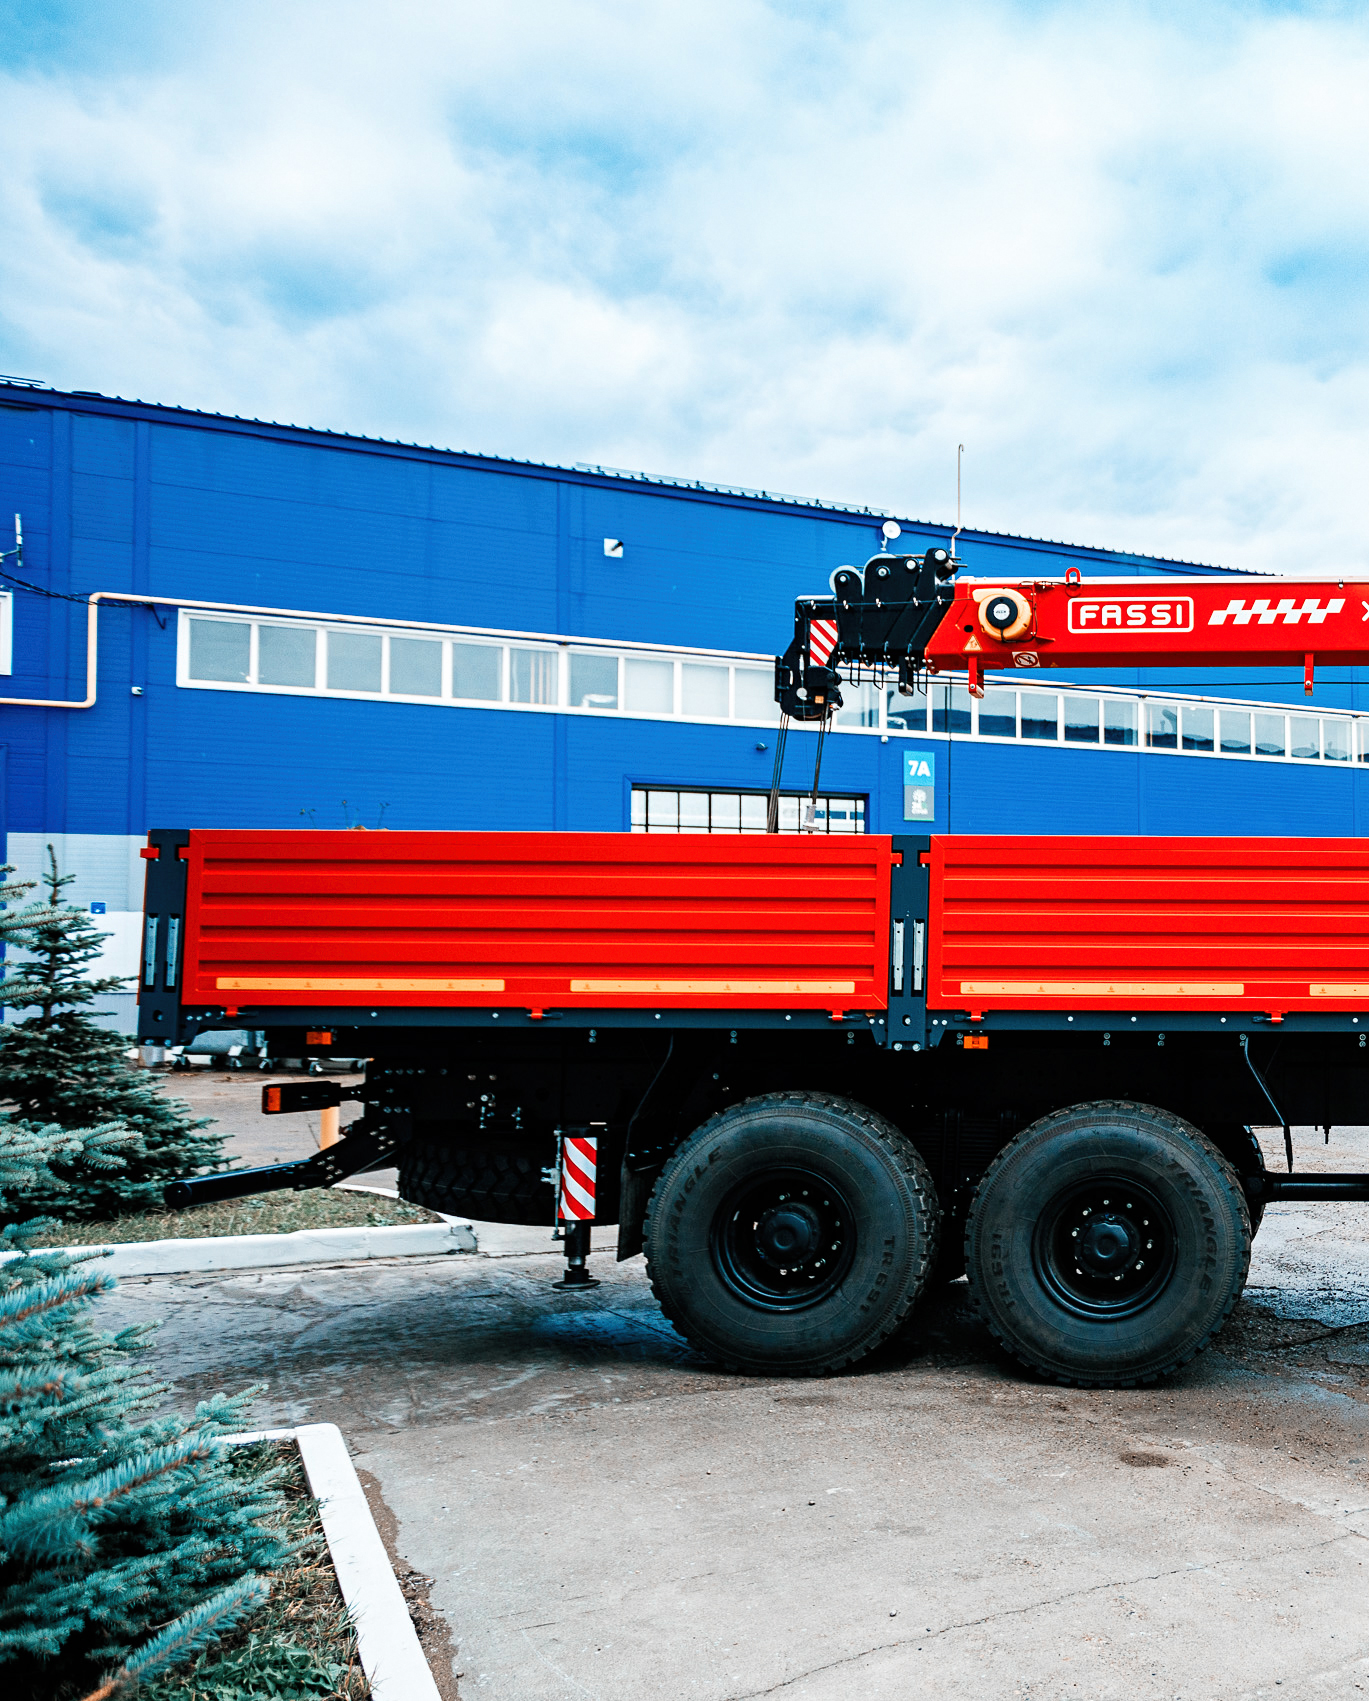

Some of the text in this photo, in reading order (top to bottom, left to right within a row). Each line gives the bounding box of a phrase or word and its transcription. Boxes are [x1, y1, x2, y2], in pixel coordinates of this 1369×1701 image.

[1080, 604, 1183, 626] FASSI
[668, 1146, 722, 1278] TRIANGLE
[1164, 1155, 1218, 1297] TRIANGLE
